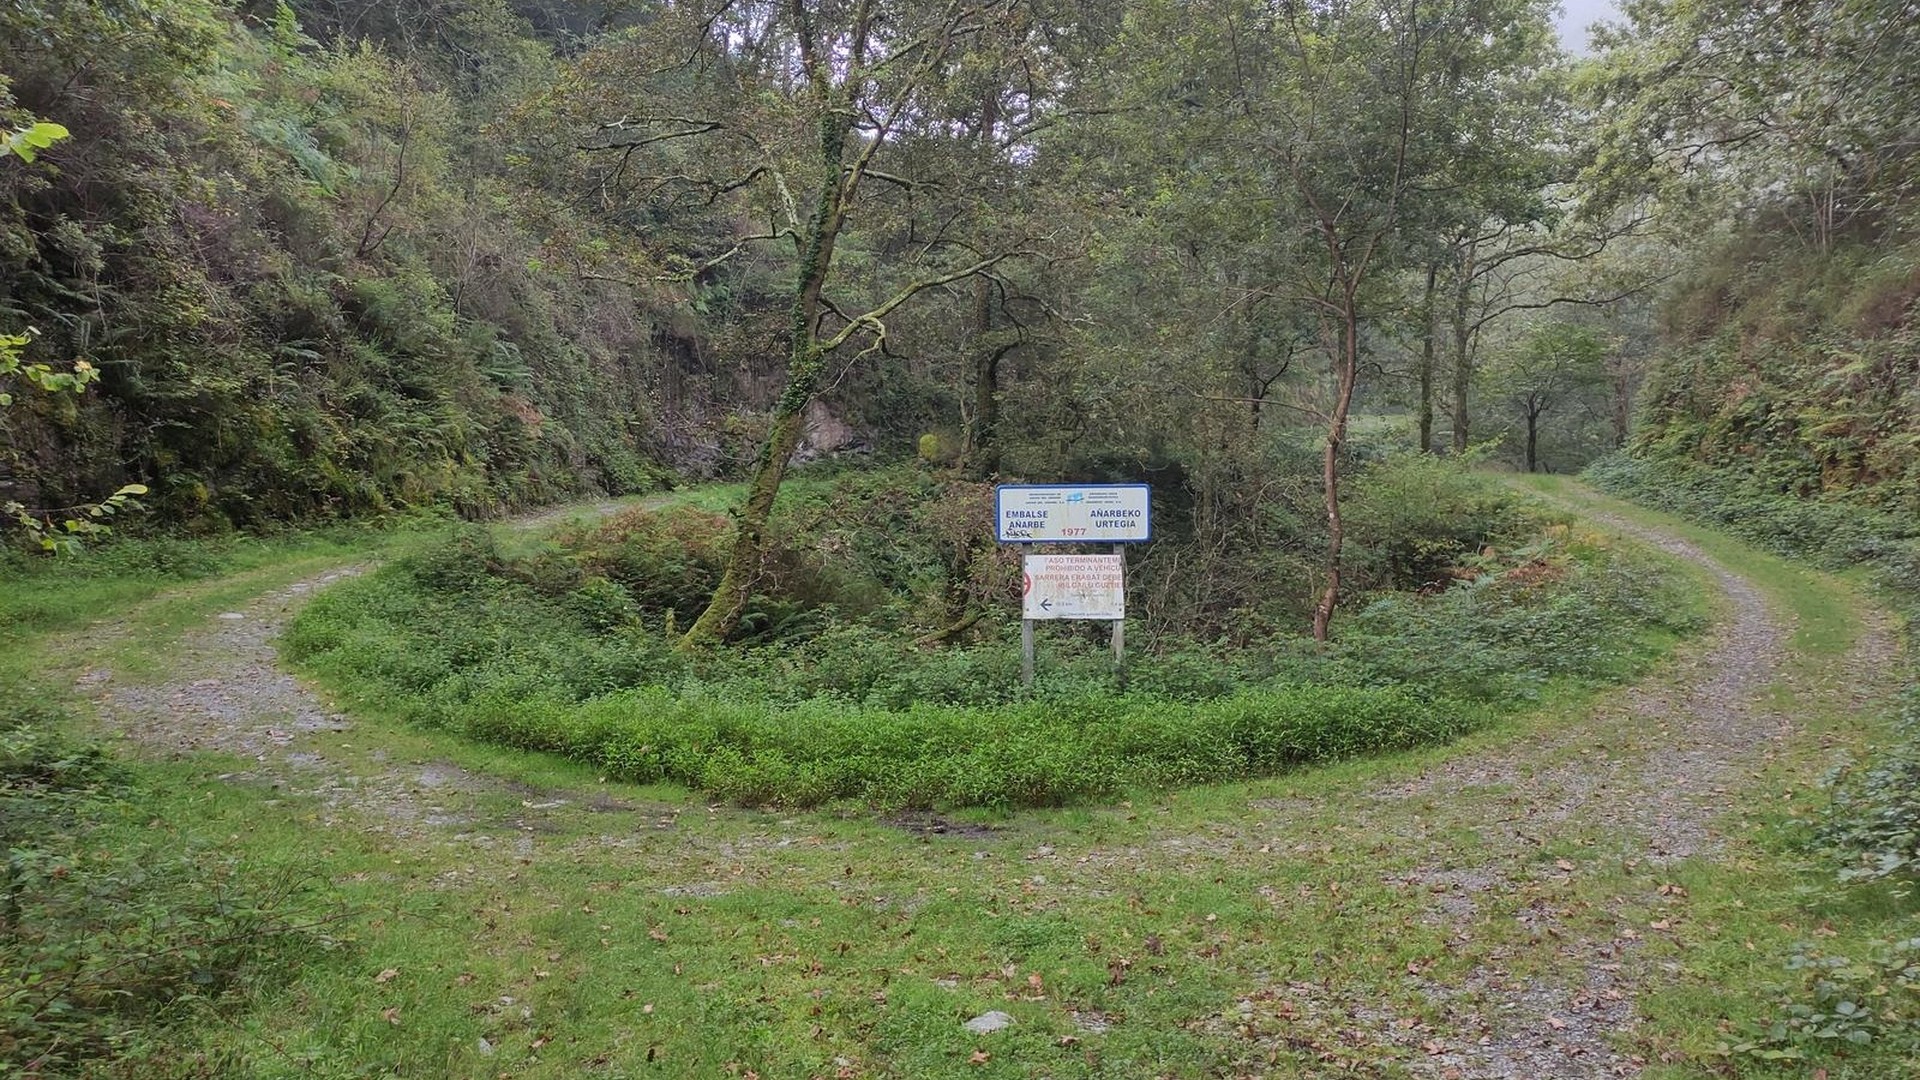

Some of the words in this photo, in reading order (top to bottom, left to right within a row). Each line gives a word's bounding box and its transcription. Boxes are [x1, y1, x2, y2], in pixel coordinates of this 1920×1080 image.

[1006, 510, 1048, 518] EMBALSE
[1090, 508, 1141, 517] AÑARBEKO
[1009, 519, 1045, 528] AÑARBE
[1095, 520, 1136, 528] URTEGIA
[1061, 528, 1087, 536] 1977
